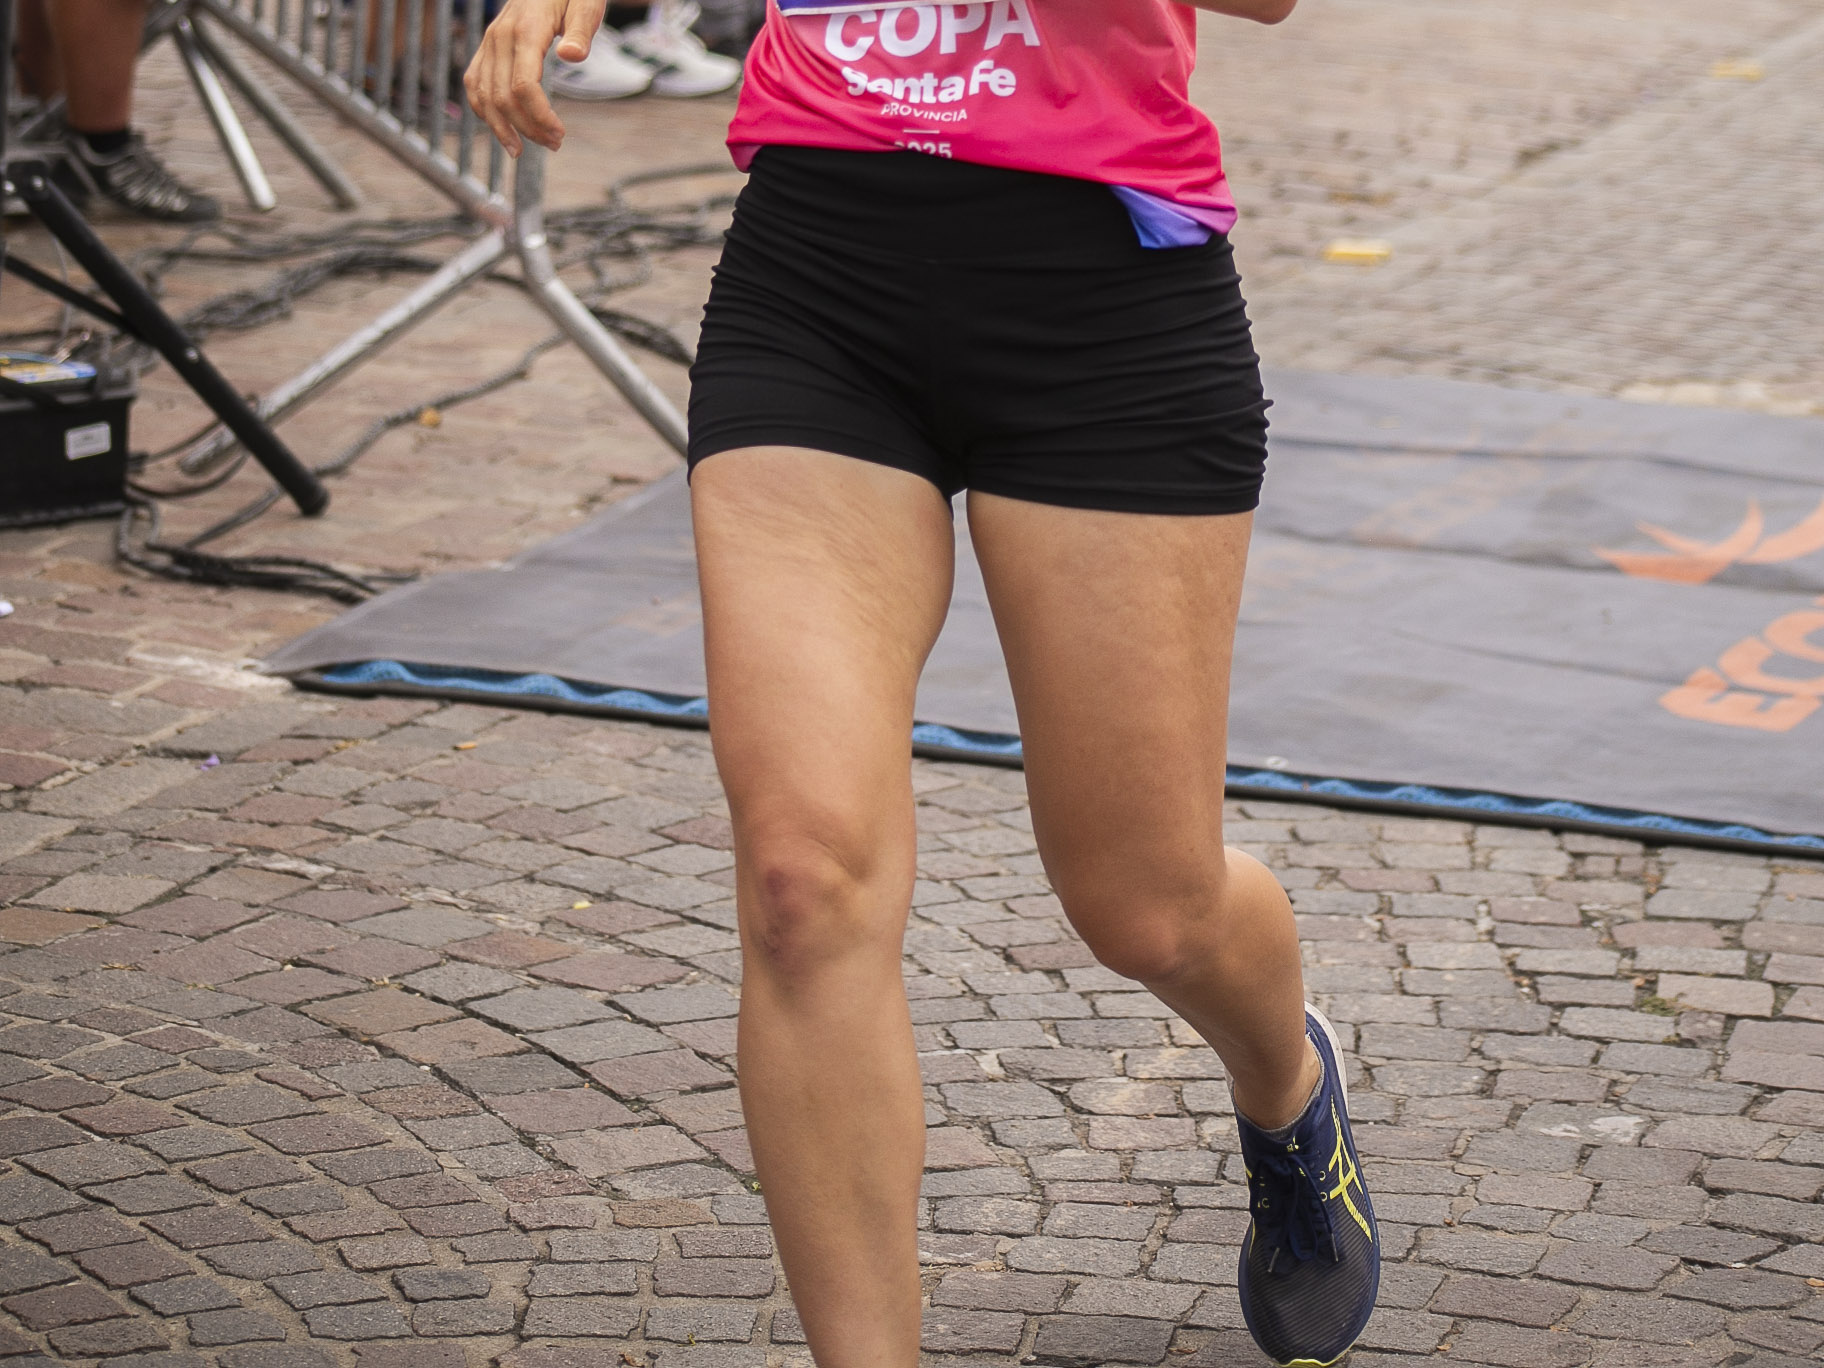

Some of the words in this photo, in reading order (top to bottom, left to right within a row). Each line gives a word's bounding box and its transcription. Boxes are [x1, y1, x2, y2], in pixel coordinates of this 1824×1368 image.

[841, 66, 966, 104] Santa
[968, 59, 1017, 97] Fe
[880, 102, 968, 122] PROVINCIA
